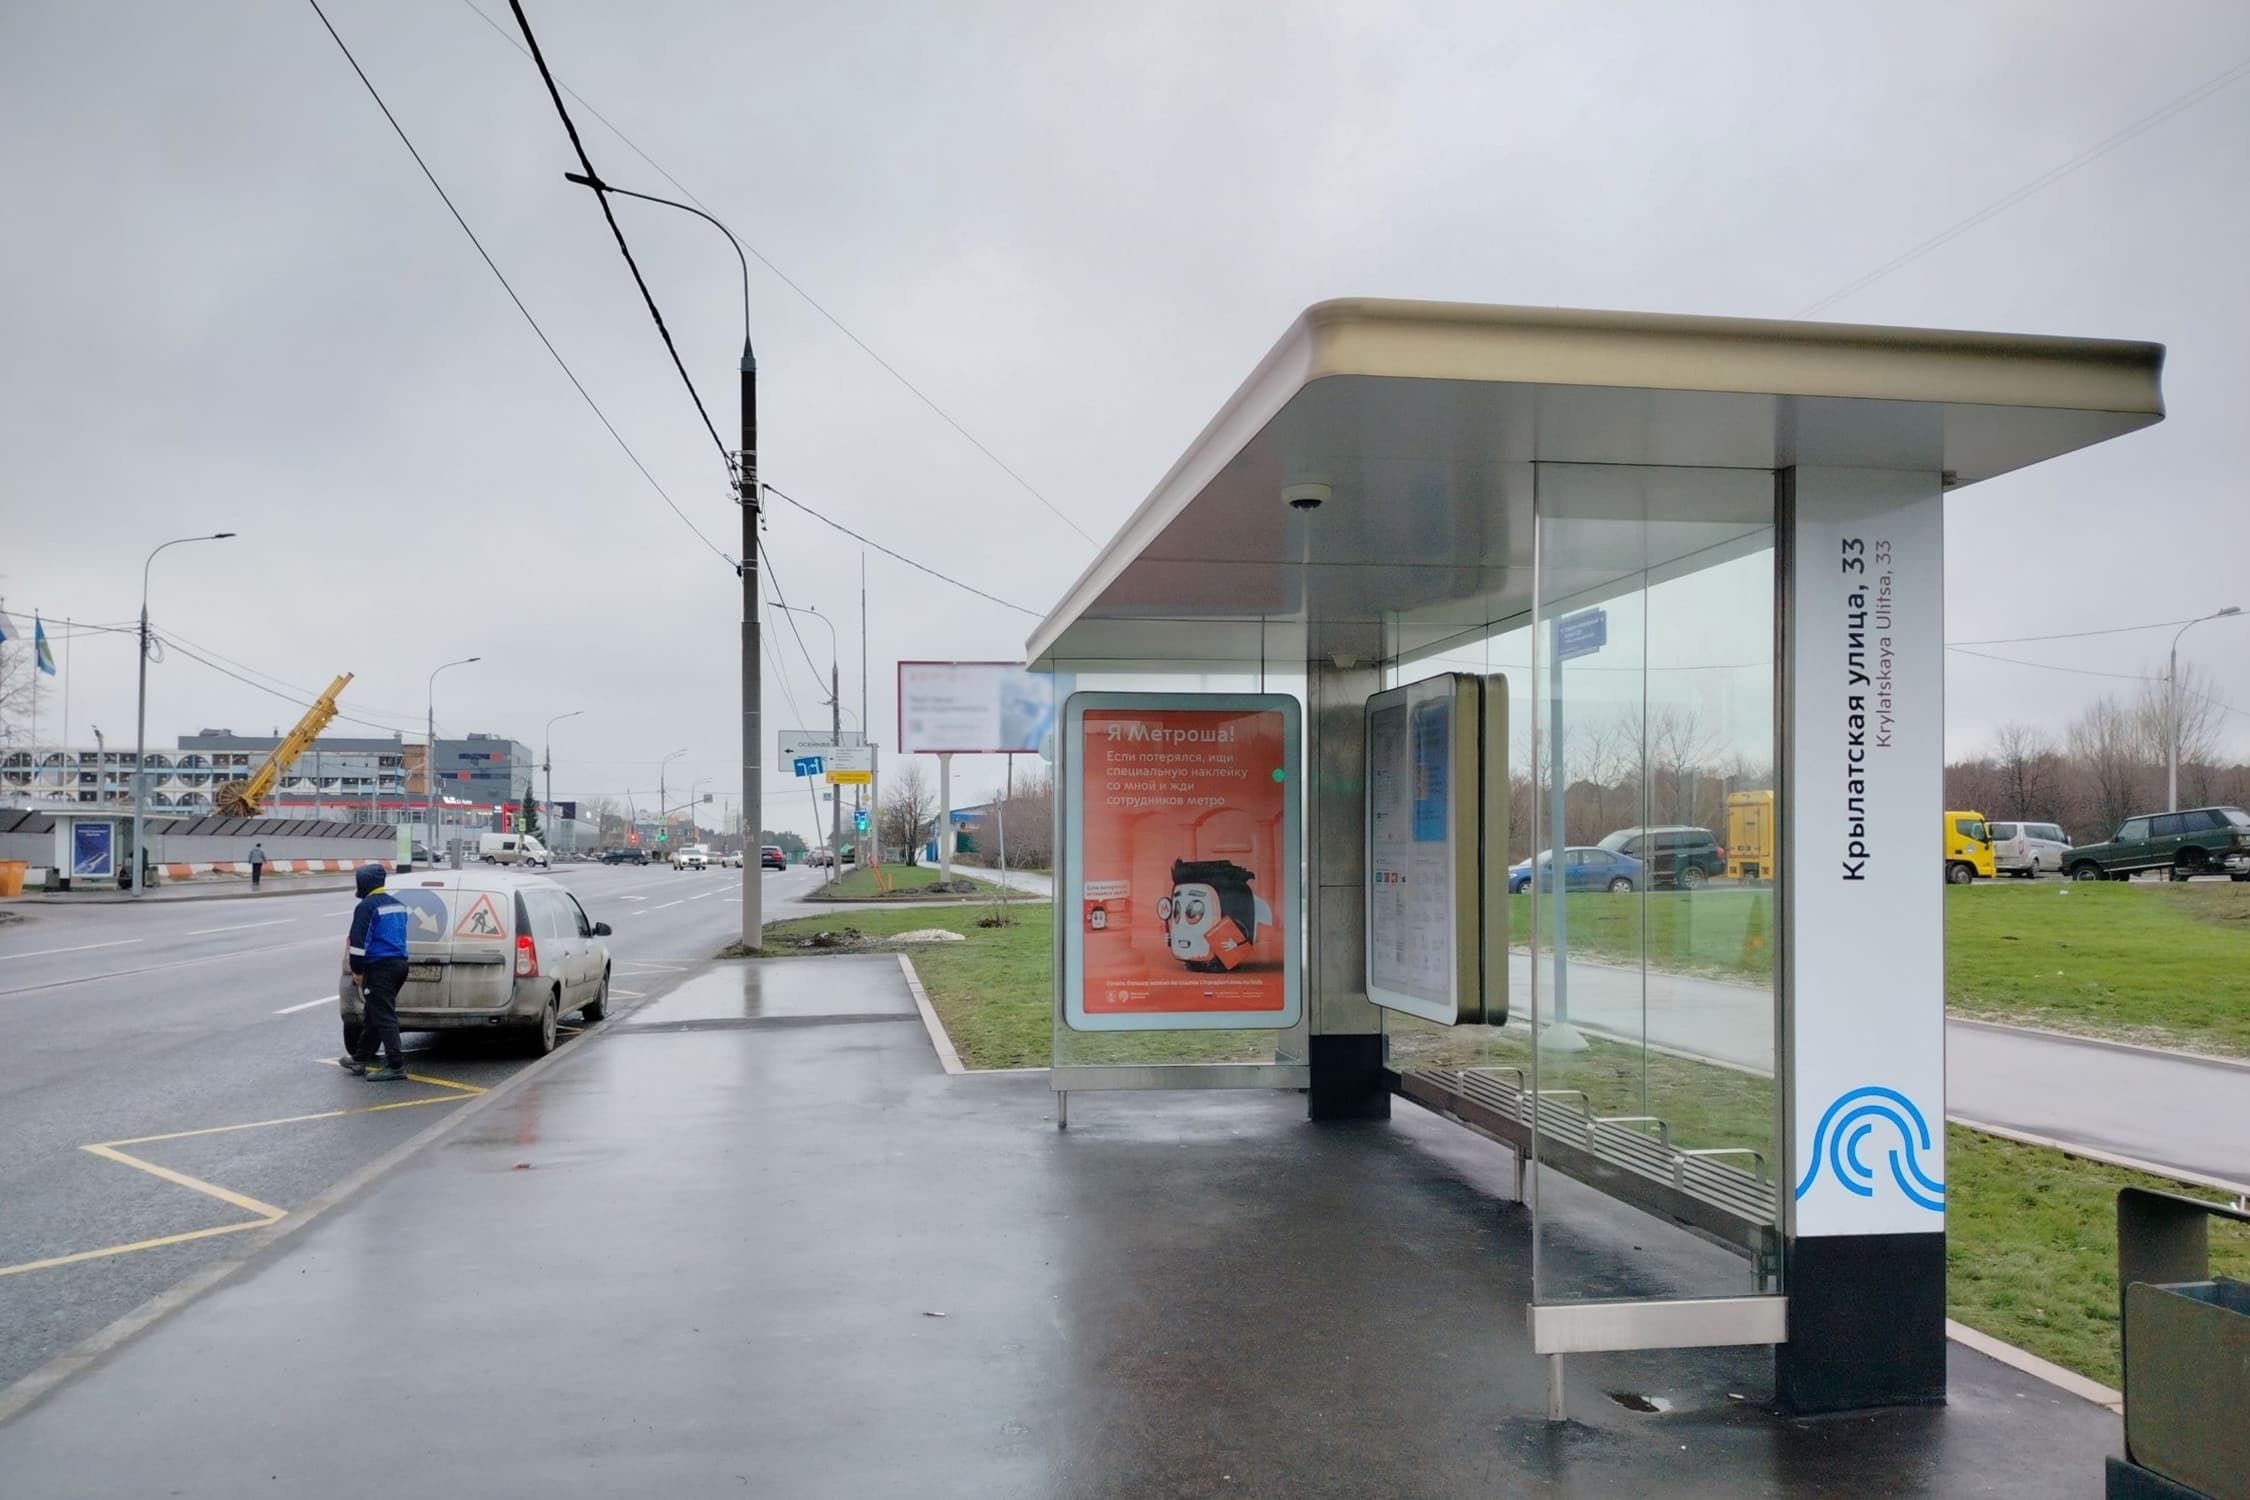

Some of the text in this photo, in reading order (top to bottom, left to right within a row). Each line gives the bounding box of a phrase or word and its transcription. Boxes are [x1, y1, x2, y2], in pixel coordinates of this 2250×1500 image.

[1875, 540, 1895, 748] Krylatskaya Ulitsa, 33
[1842, 538, 1870, 881] Крылатская улица, 33
[1107, 724, 1234, 745] Я Метроша!
[1106, 750, 1234, 764] Если потерялся, ищи
[1106, 766, 1248, 779] специальную наклейку
[1124, 781, 1156, 791] мной
[1159, 783, 1167, 791] и
[1170, 783, 1195, 792] жди
[1106, 796, 1225, 808] сотрудников метро
